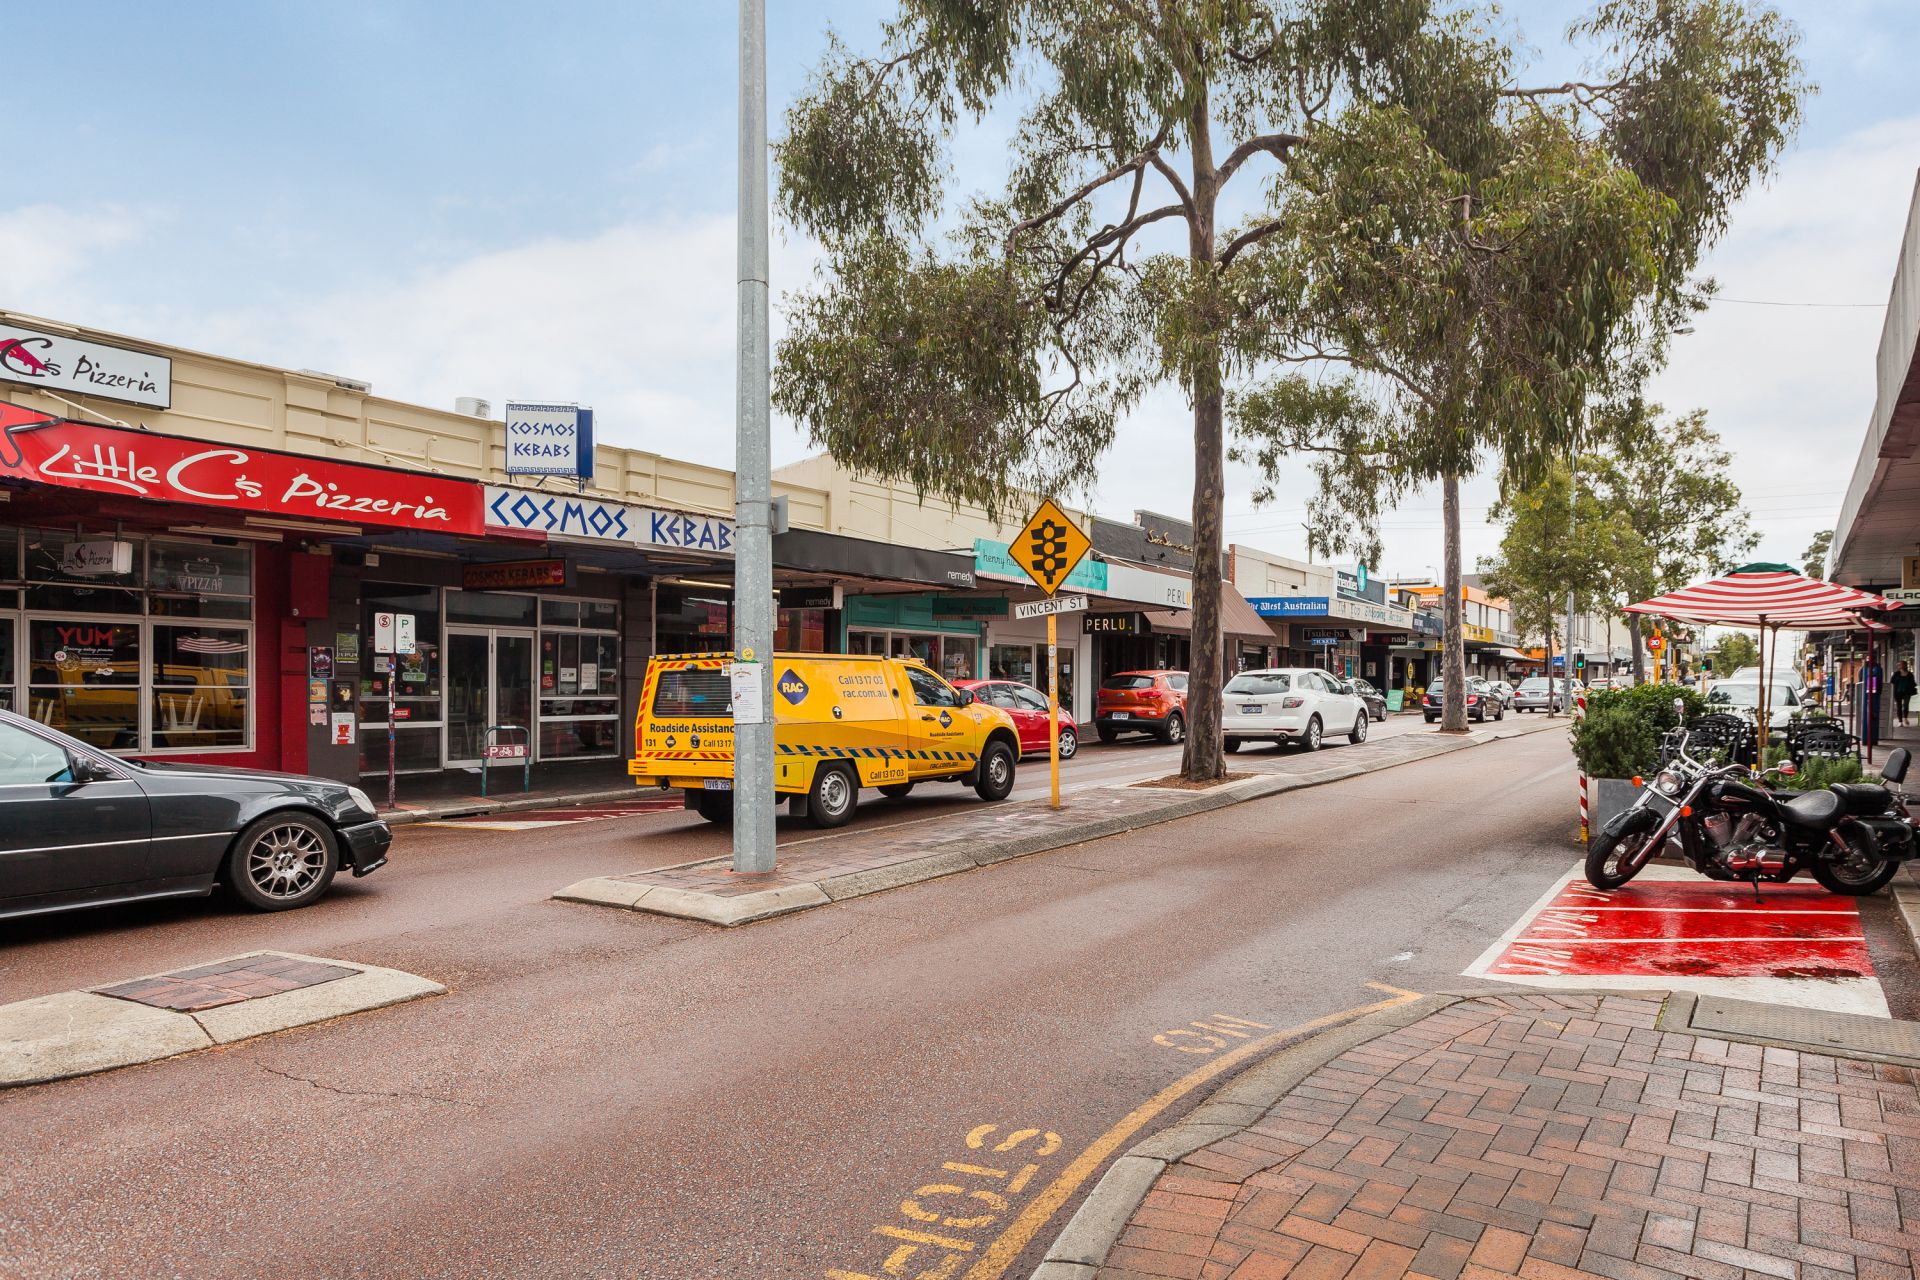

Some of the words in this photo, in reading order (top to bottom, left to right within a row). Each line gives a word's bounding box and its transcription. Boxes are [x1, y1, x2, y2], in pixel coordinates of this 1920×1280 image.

[72, 354, 157, 394] Pizzeria
[510, 421, 575, 437] COSMOS
[514, 442, 570, 458] KEBABS
[40, 443, 160, 495] Little
[166, 449, 262, 500] C's
[281, 472, 452, 521] Pizzeria
[490, 491, 629, 539] COSMOS
[651, 511, 736, 550] KEBAB
[508, 567, 549, 580] KEBABS
[947, 570, 974, 584] remedy
[187, 576, 218, 590] PIZZA
[805, 598, 831, 608] remedy
[1018, 601, 1064, 617] VINCENT
[1069, 596, 1084, 609] ST
[1260, 602, 1281, 611] West
[1283, 601, 1327, 611] Australian
[401, 619, 409, 629] P
[56, 626, 113, 646] YUM
[1391, 635, 1407, 644] nab
[838, 675, 854, 685] Call
[854, 675, 864, 685] 13
[864, 675, 873, 685] 17
[872, 675, 884, 685] 03
[782, 682, 804, 694] RAC
[842, 689, 888, 699] rac.com.au
[650, 723, 690, 733] Roadside
[691, 723, 734, 734] Assistanc
[645, 739, 656, 747] 131
[703, 740, 716, 748] Call
[716, 740, 724, 748] 13
[725, 740, 732, 748] 17
[489, 747, 498, 757] P
[882, 770, 889, 778] 13
[889, 769, 896, 777] 17
[896, 769, 905, 777] 03
[1151, 1012, 1271, 1055] NO
